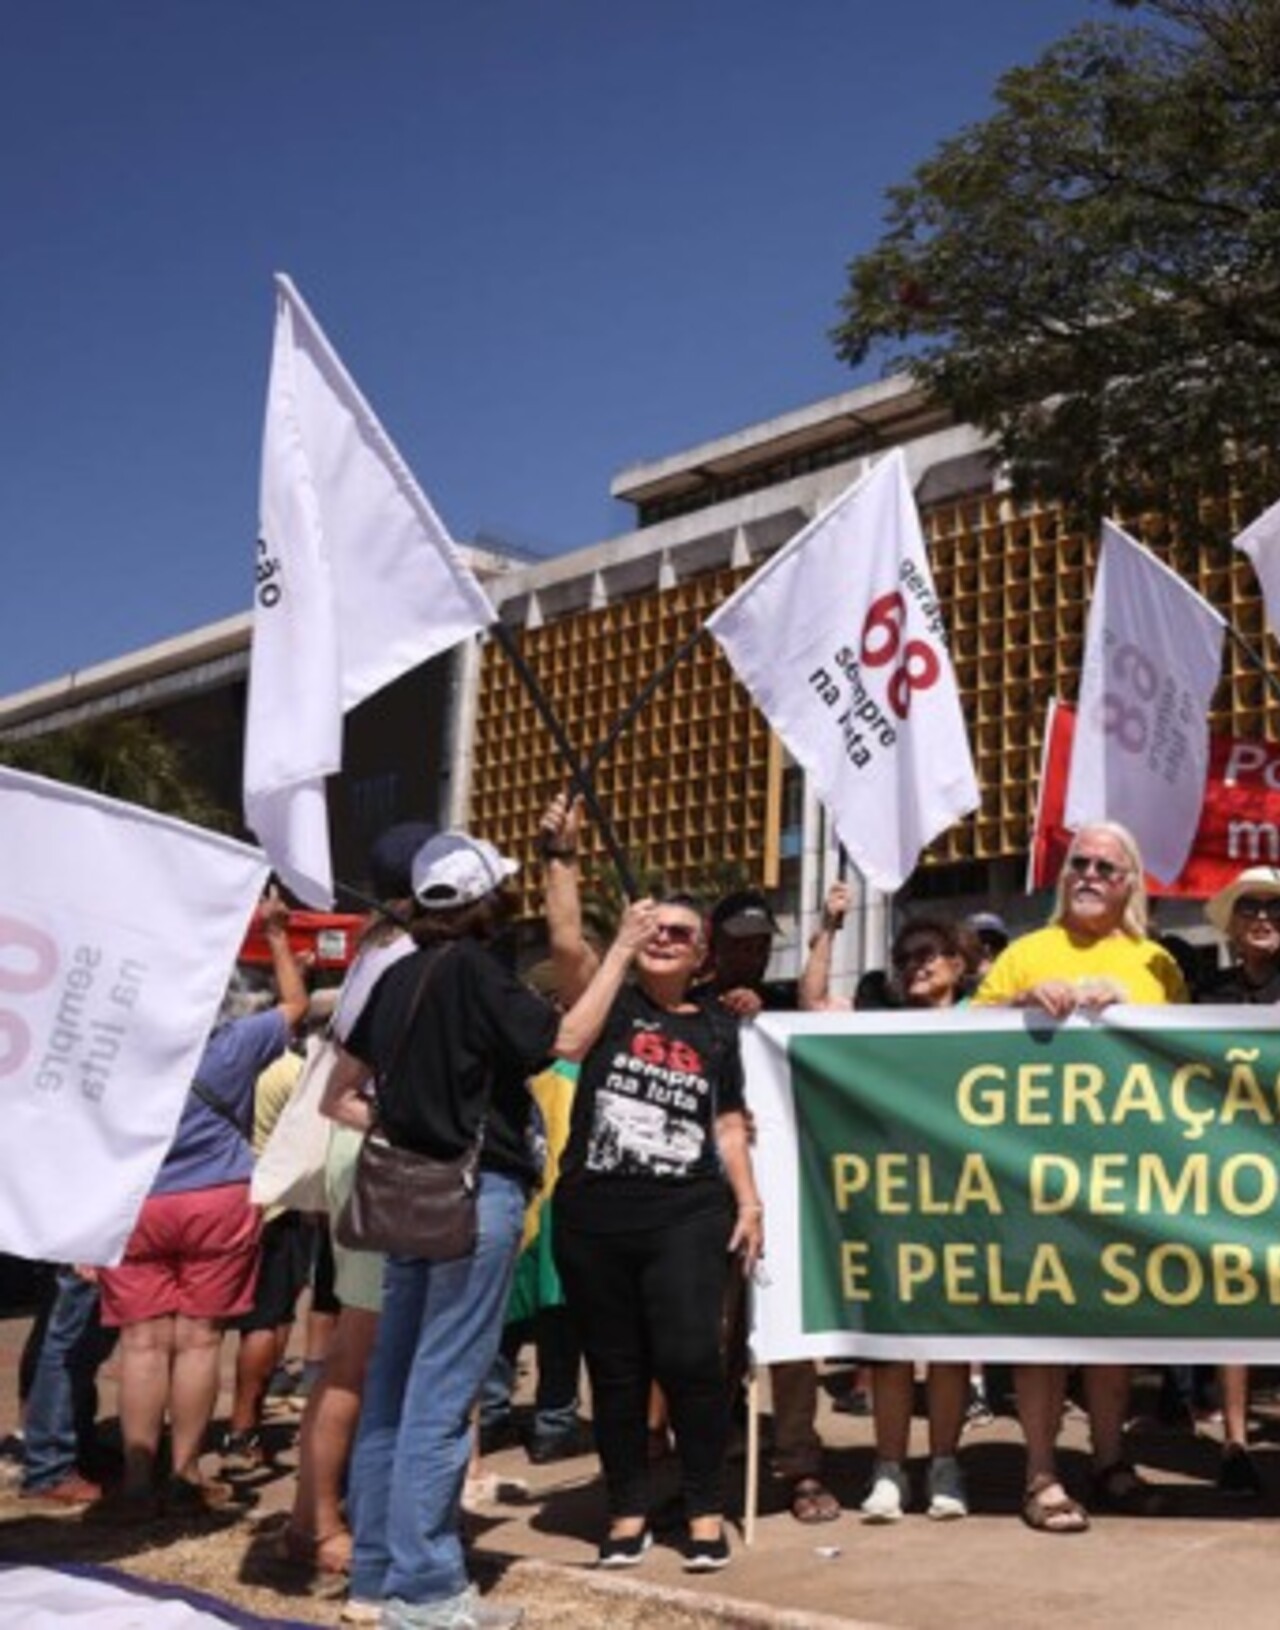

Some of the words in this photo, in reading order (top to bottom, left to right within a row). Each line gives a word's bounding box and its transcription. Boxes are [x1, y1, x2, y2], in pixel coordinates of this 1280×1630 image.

[860, 591, 940, 720] 68
[808, 667, 841, 708] na
[837, 709, 871, 769] lta
[606, 1073, 639, 1094] na
[645, 1081, 698, 1112] luta
[613, 1053, 709, 1095] sempre
[833, 1153, 1002, 1215] PELA
[840, 1243, 870, 1301] E
[899, 1244, 1076, 1305] PELA
